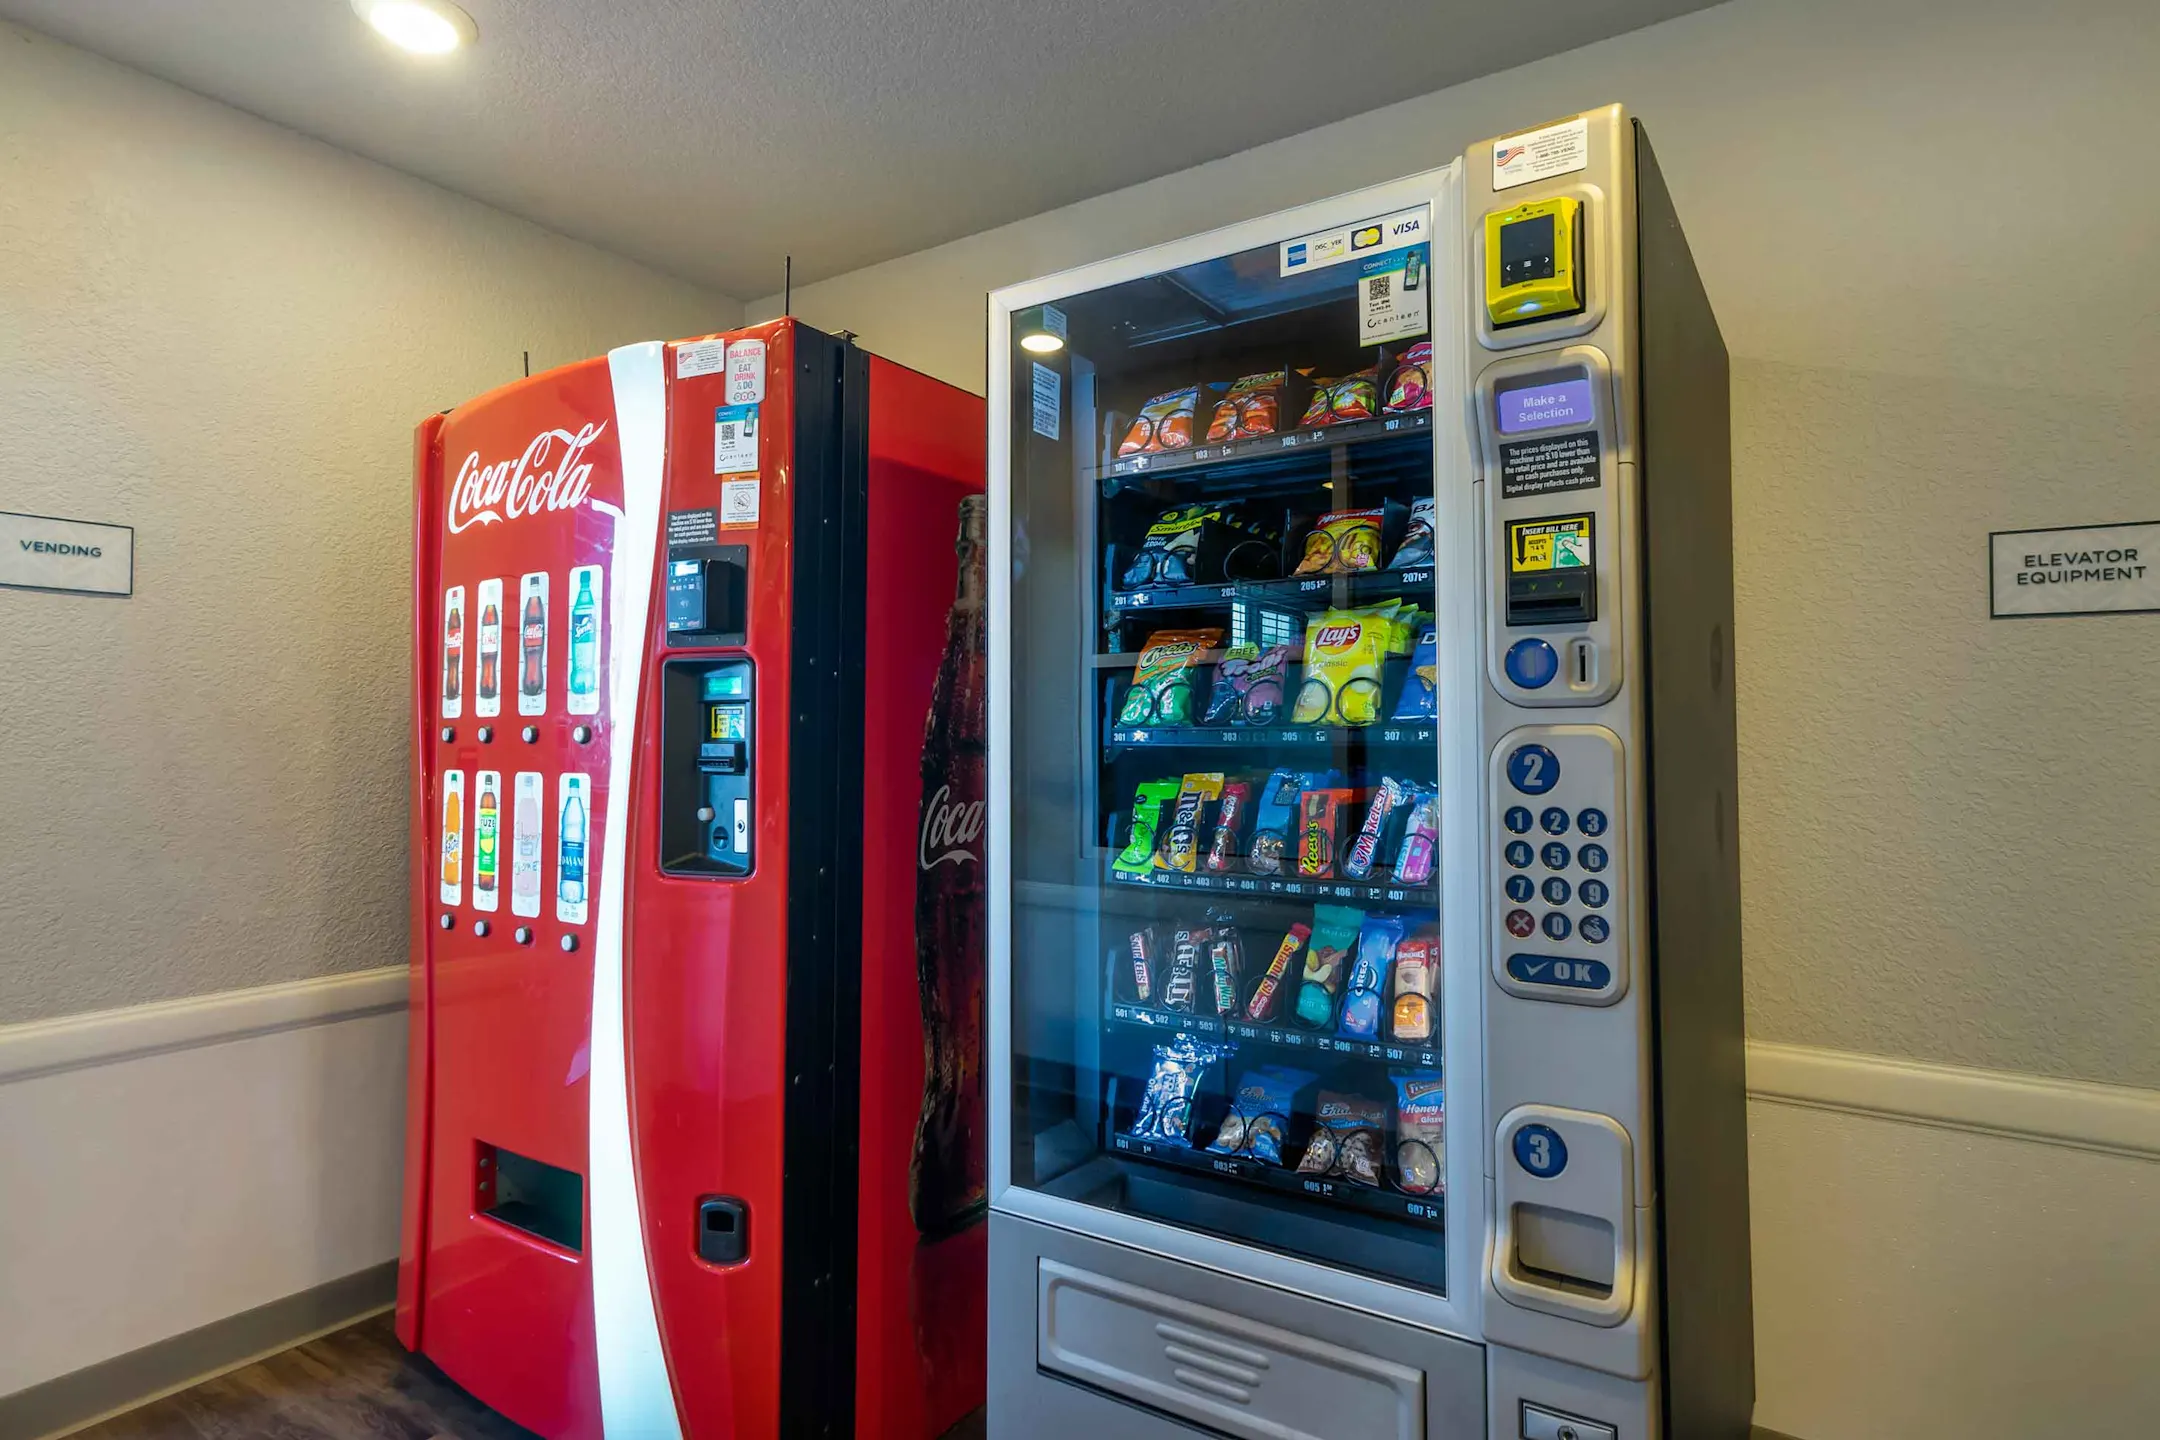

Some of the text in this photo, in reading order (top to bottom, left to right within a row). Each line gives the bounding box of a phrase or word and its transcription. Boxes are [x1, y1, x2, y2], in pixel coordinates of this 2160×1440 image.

[1393, 220, 1420, 235] VISA
[730, 347, 761, 359] BALANCE
[738, 363, 751, 372] EAT
[734, 372, 756, 381] DRINK
[743, 380, 753, 389] DO
[1523, 394, 1567, 408] Make a
[1519, 407, 1574, 422] Selection
[1384, 419, 1399, 430] 107
[1281, 435, 1296, 448] 105
[1509, 438, 1589, 457] The prices displayed on this
[1195, 449, 1208, 460] 103
[1509, 455, 1534, 465] machine
[1559, 450, 1576, 458] lower
[1576, 447, 1590, 455] than
[1115, 462, 1126, 473] 101
[1504, 455, 1596, 474] the retail price and are available
[449, 419, 608, 534] Coca-Cola
[1515, 474, 1524, 482] on
[1525, 472, 1539, 481] cash
[1539, 468, 1570, 480] purchases
[1506, 484, 1524, 494] Digital
[1524, 481, 1543, 490] display
[1543, 478, 1565, 488] reflects
[1565, 476, 1579, 485] cash
[1522, 522, 1579, 536] INSERT BILL HERE
[20, 539, 102, 558] VENDING
[2024, 548, 2139, 568] ELEVATOR
[1402, 572, 1418, 583] 207
[2017, 565, 2147, 586] EQUIPMENT
[1221, 588, 1236, 597] 203
[1300, 582, 1316, 591] 205
[1114, 597, 1127, 605] 201
[1317, 625, 1359, 647] Lay's
[1140, 641, 1200, 671] Cheetos
[1113, 733, 1126, 742] 301
[1222, 732, 1237, 741] 303
[1282, 731, 1298, 741] 305
[1384, 731, 1400, 741] 307
[1523, 753, 1543, 786] 2
[920, 784, 985, 871] Coca
[1513, 811, 1599, 832] 1 2 3
[1352, 851, 1369, 867] 3
[1514, 845, 1600, 868] 4 5 6
[1115, 871, 1127, 880] 401
[1156, 873, 1170, 883] 402
[1196, 877, 1210, 886] 403
[1240, 880, 1255, 890] 404
[1286, 883, 1301, 893] 405
[1516, 879, 1600, 902] 7 8 9
[1334, 886, 1350, 897] 406
[1388, 890, 1404, 900] 407
[1552, 916, 1564, 935] 0
[1554, 962, 1592, 983] OK
[1115, 1008, 1128, 1018] 501
[1155, 1014, 1169, 1024] 502
[1199, 1021, 1214, 1031] 503
[1240, 1027, 1255, 1037] 504
[1285, 1034, 1300, 1044] 505
[1334, 1040, 1350, 1052] 506
[1386, 1048, 1402, 1060] 507
[1406, 1103, 1439, 1115] Honey
[1529, 1133, 1550, 1170] 3
[1303, 1180, 1320, 1192] 605
[1407, 1202, 1424, 1216] 607
